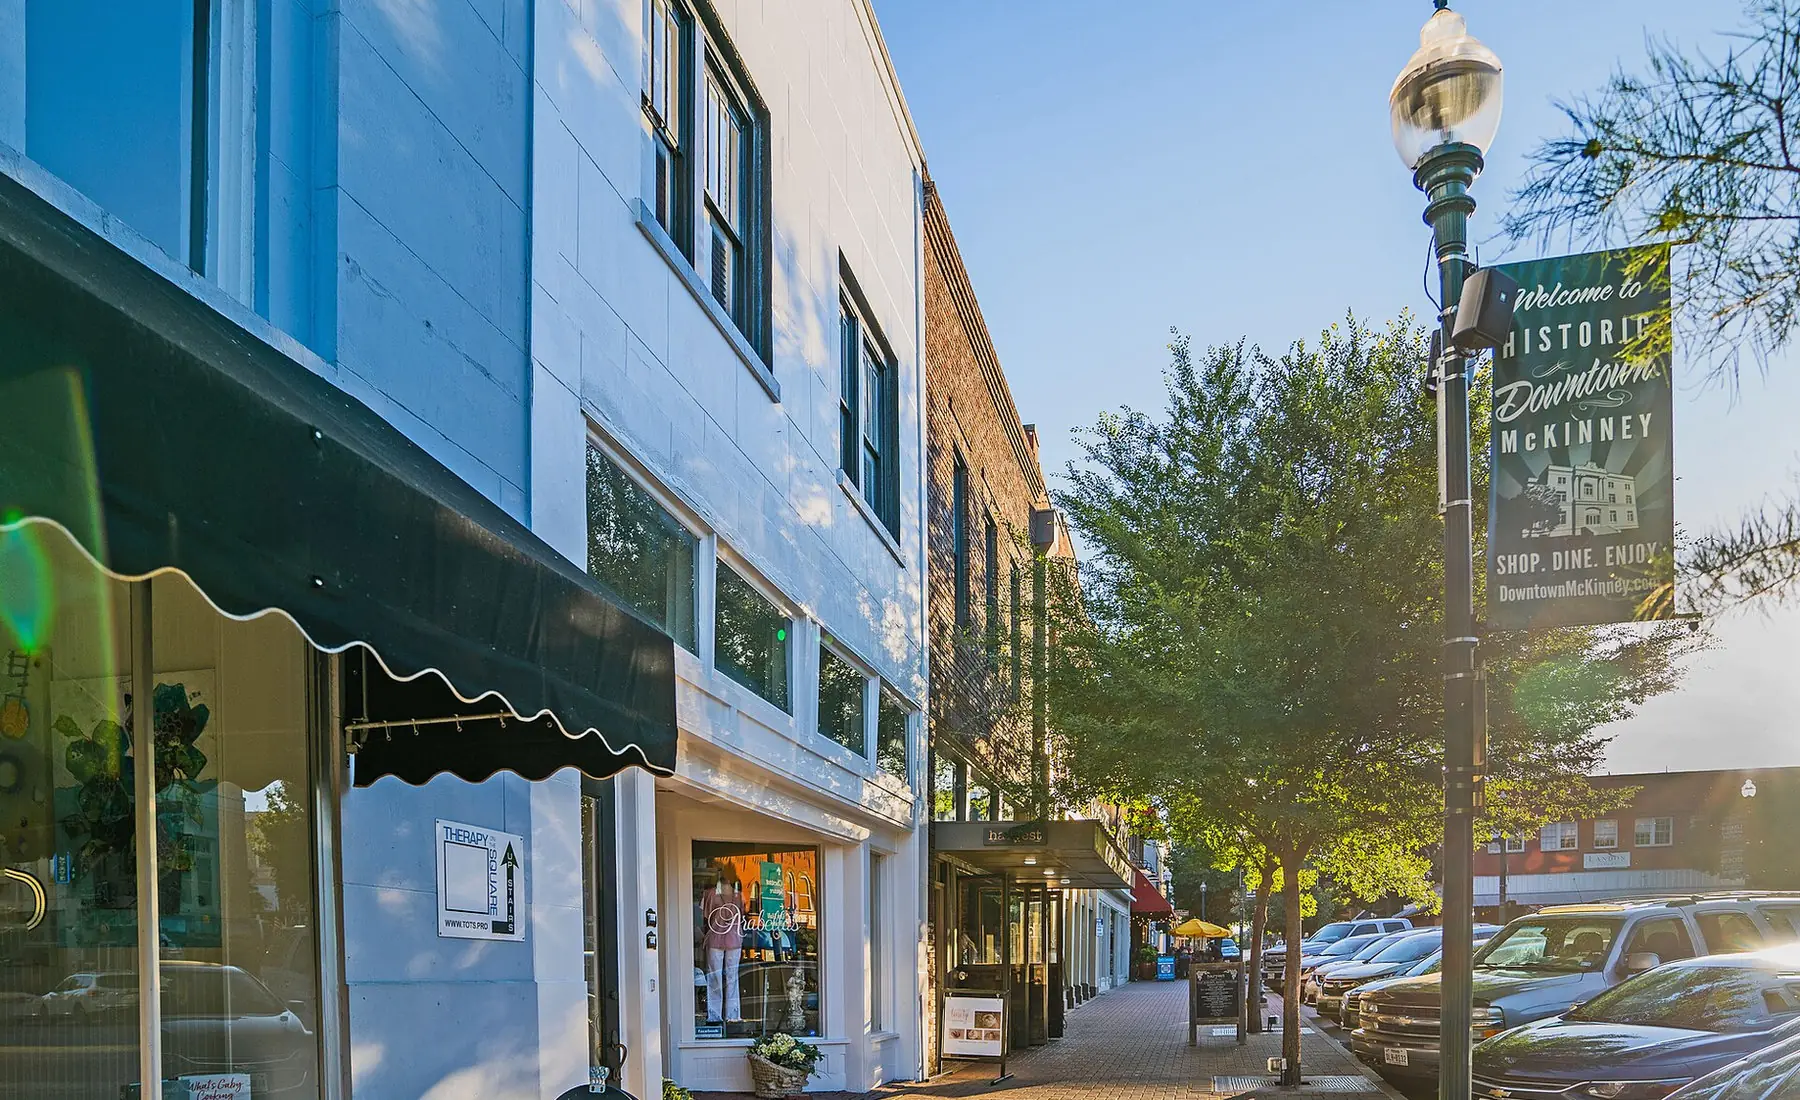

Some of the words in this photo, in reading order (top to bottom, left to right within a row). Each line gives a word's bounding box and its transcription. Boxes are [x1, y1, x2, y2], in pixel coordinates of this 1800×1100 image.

[1513, 282, 1614, 313] Welcome
[1618, 278, 1642, 299] to
[1502, 316, 1650, 359] HISTORIC
[1494, 358, 1660, 423] Downtown
[1501, 412, 1652, 454] McKINNEY
[1496, 553, 1546, 575] SHOP.
[1552, 548, 1598, 571] DINE.
[443, 826, 489, 846] THERAPY
[988, 829, 1043, 842] haest
[507, 852, 514, 869] UP
[489, 848, 498, 917] SQUARE
[445, 919, 489, 930] WWW.TOTS.PRO
[196, 1090, 234, 1100] Cooking
[218, 1078, 243, 1093] Gaby
